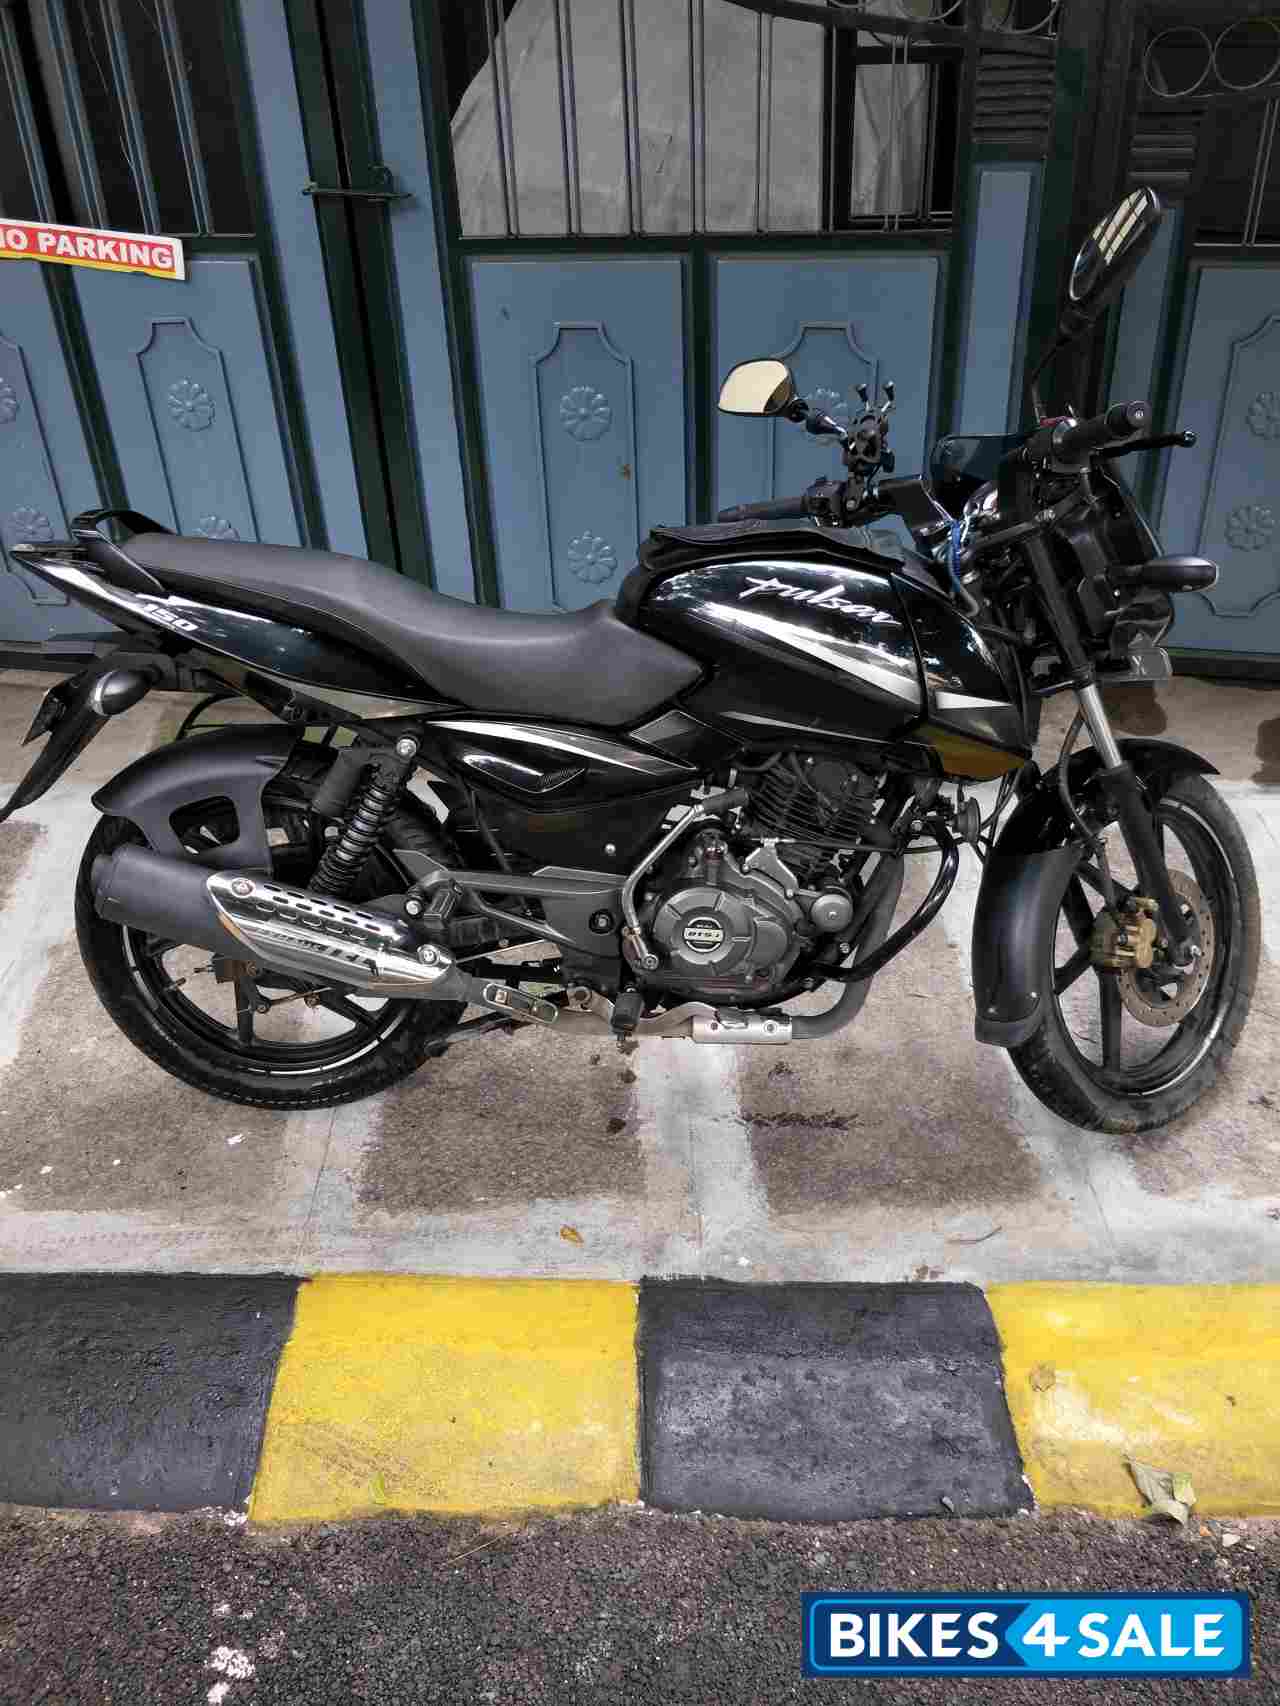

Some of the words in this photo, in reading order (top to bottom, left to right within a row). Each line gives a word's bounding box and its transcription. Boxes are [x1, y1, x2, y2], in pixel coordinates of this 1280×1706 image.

[0, 228, 28, 251] O
[37, 231, 173, 269] PARKING
[143, 603, 200, 631] 150
